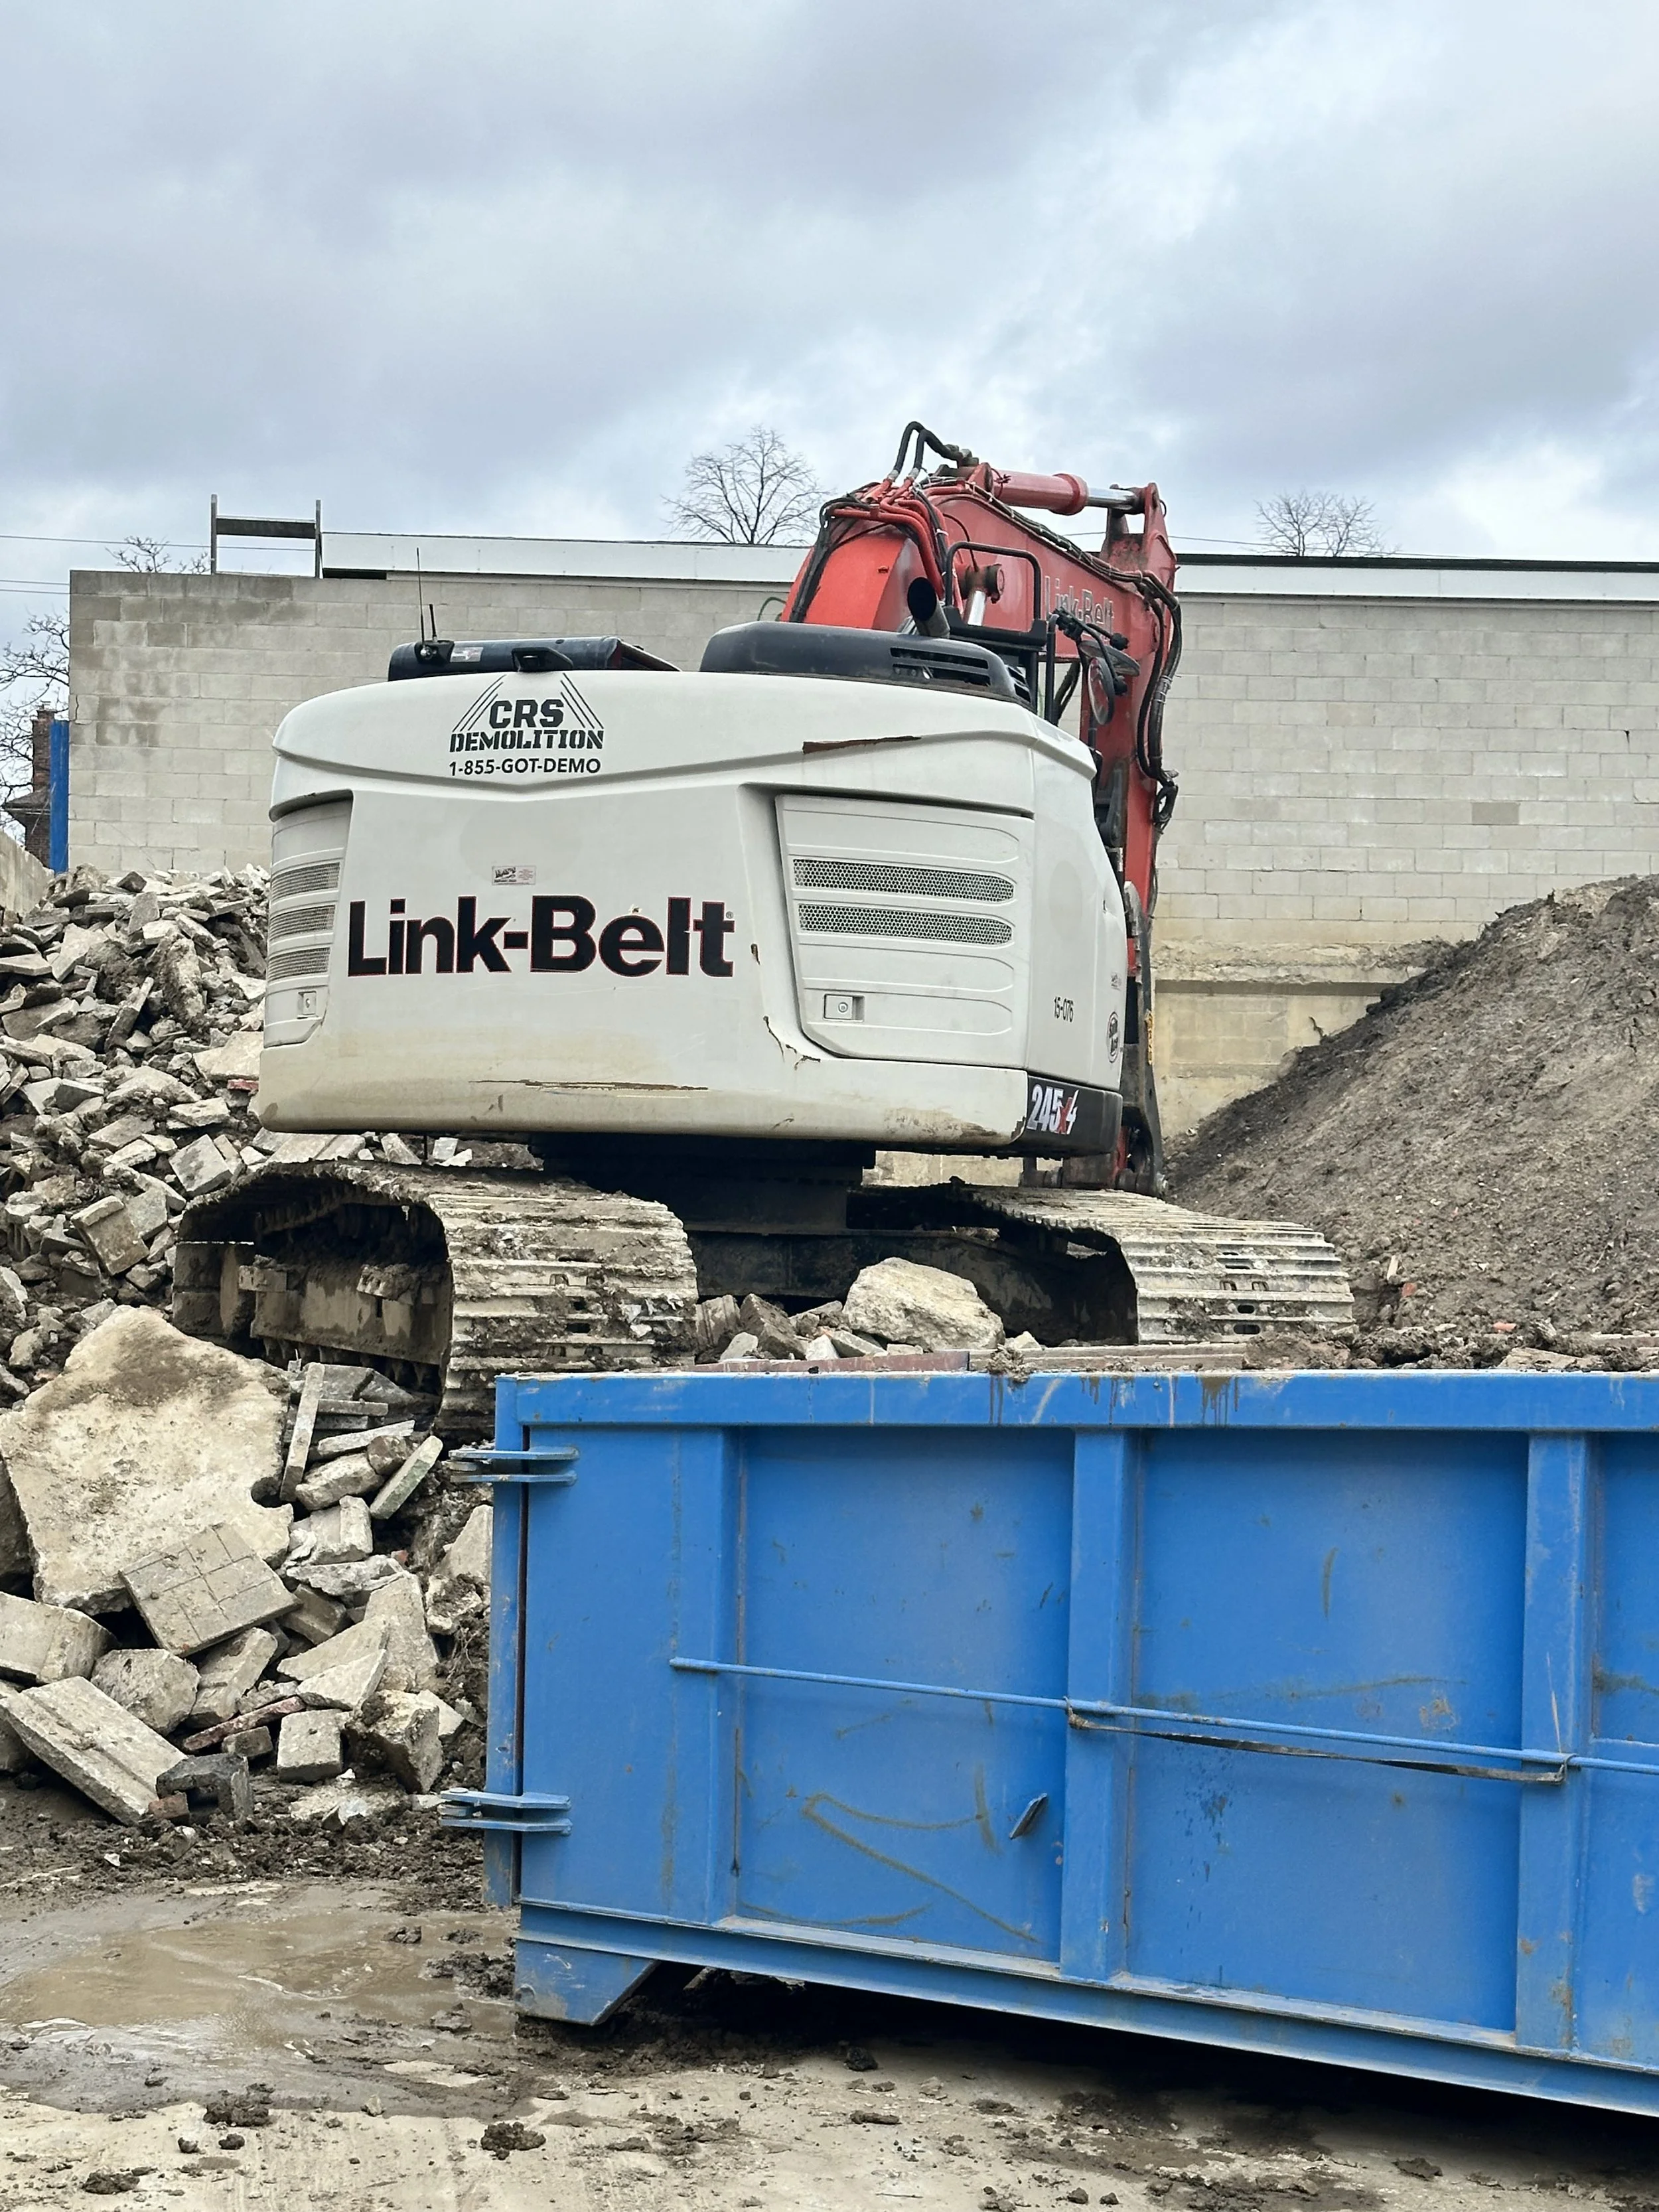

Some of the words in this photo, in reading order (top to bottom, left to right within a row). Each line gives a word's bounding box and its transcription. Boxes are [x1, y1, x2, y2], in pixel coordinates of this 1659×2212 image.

[489, 699, 564, 729] CRS
[449, 729, 604, 753] DEMOLITION
[449, 758, 601, 776] 1-855-GOT-DEMO
[1053, 996, 1074, 1023] 15-076
